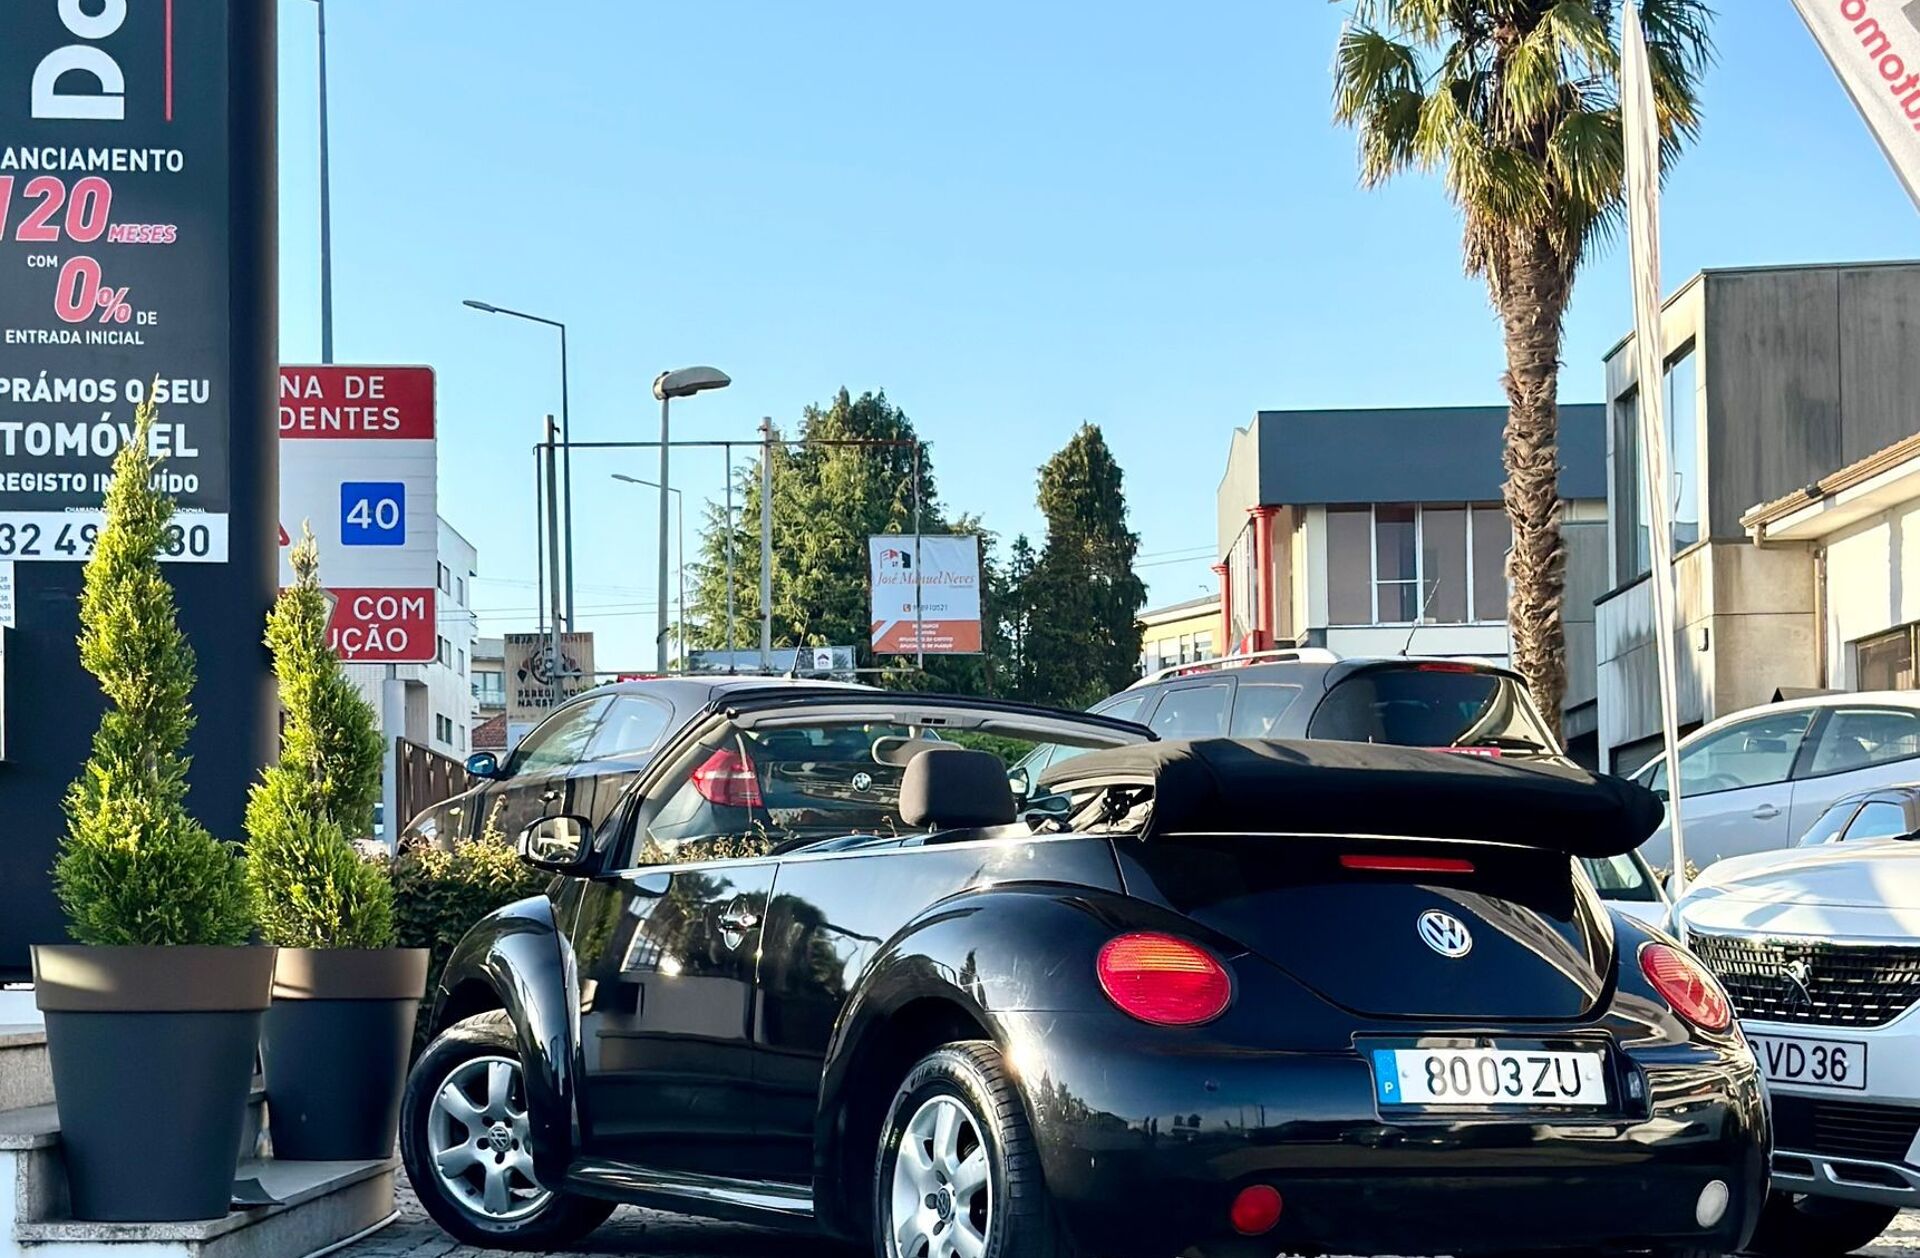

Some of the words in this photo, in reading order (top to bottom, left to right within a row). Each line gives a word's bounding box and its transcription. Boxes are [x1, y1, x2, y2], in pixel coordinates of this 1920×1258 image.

[0, 147, 184, 172] ANCIAMENTO
[107, 224, 177, 244] MESES
[27, 255, 58, 268] COM
[136, 311, 158, 325] DE
[5, 329, 82, 344] ENTRADA
[86, 330, 144, 345] INICIAL
[125, 379, 144, 403] O
[152, 379, 209, 404] SEU
[280, 375, 324, 399] NA
[345, 375, 385, 399] DE
[280, 406, 400, 431] DENTES
[93, 468, 199, 493] INUÍDO
[346, 498, 400, 530] 40
[353, 596, 425, 621] COM
[1384, 1083, 1394, 1095] P
